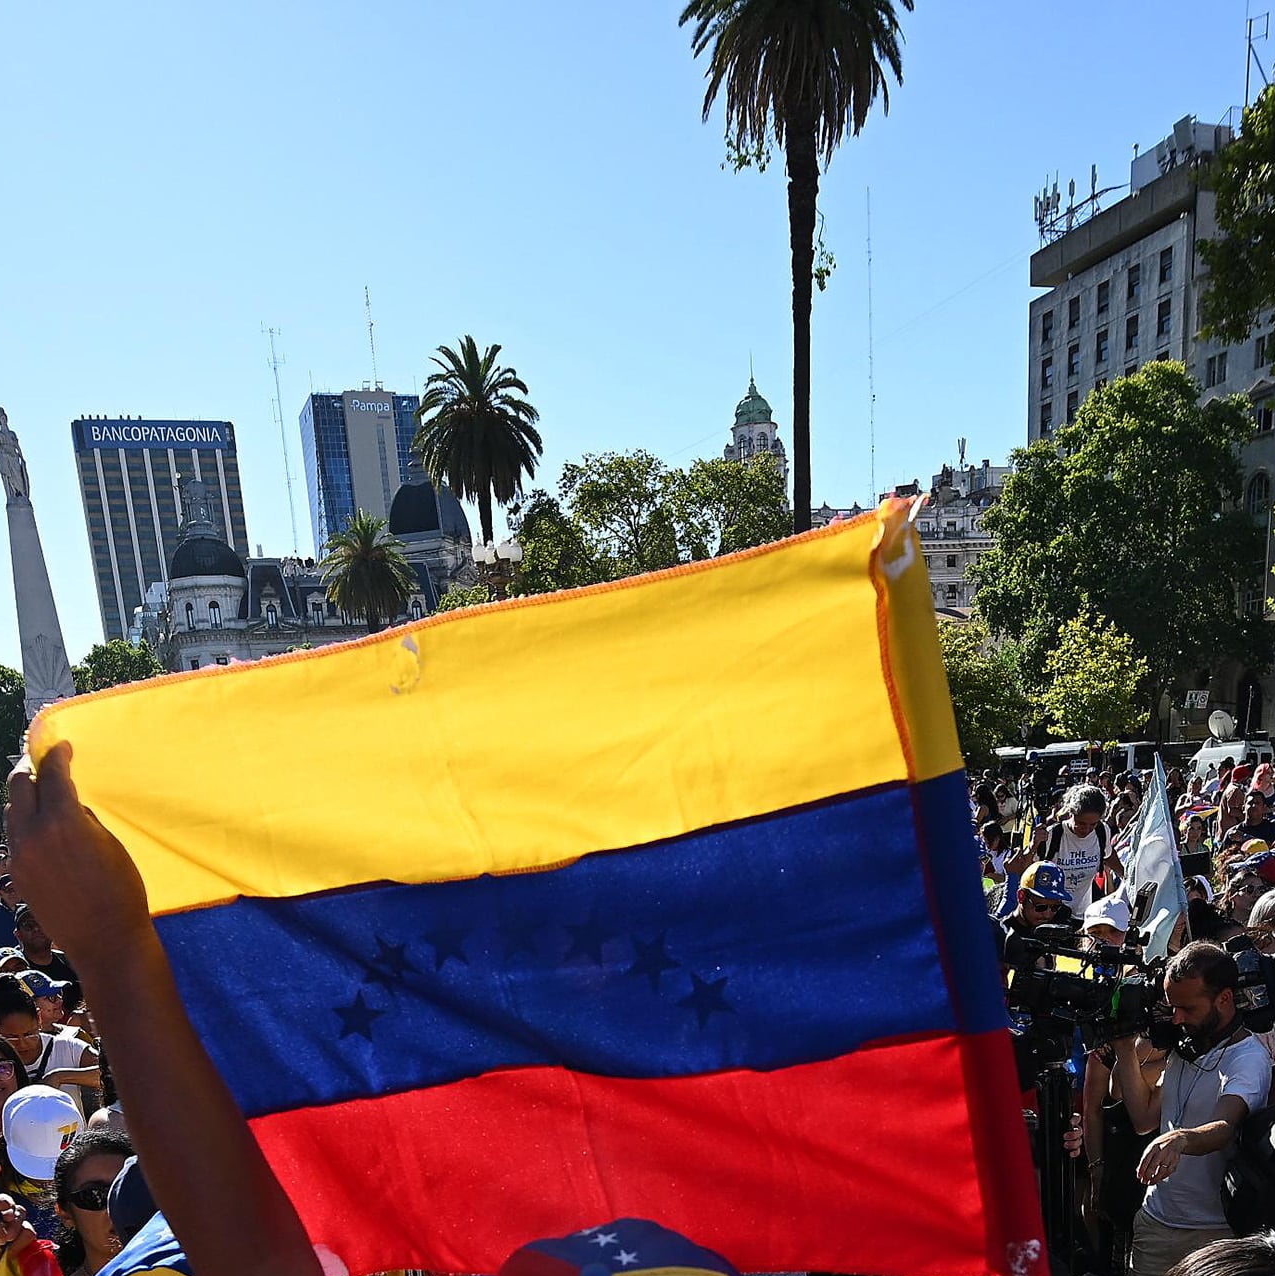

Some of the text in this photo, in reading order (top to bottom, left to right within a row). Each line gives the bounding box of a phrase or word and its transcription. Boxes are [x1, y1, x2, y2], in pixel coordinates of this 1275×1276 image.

[351, 399, 391, 413] Pampa
[91, 425, 222, 443] BANCOPATAGONIA
[1070, 850, 1086, 858] THE
